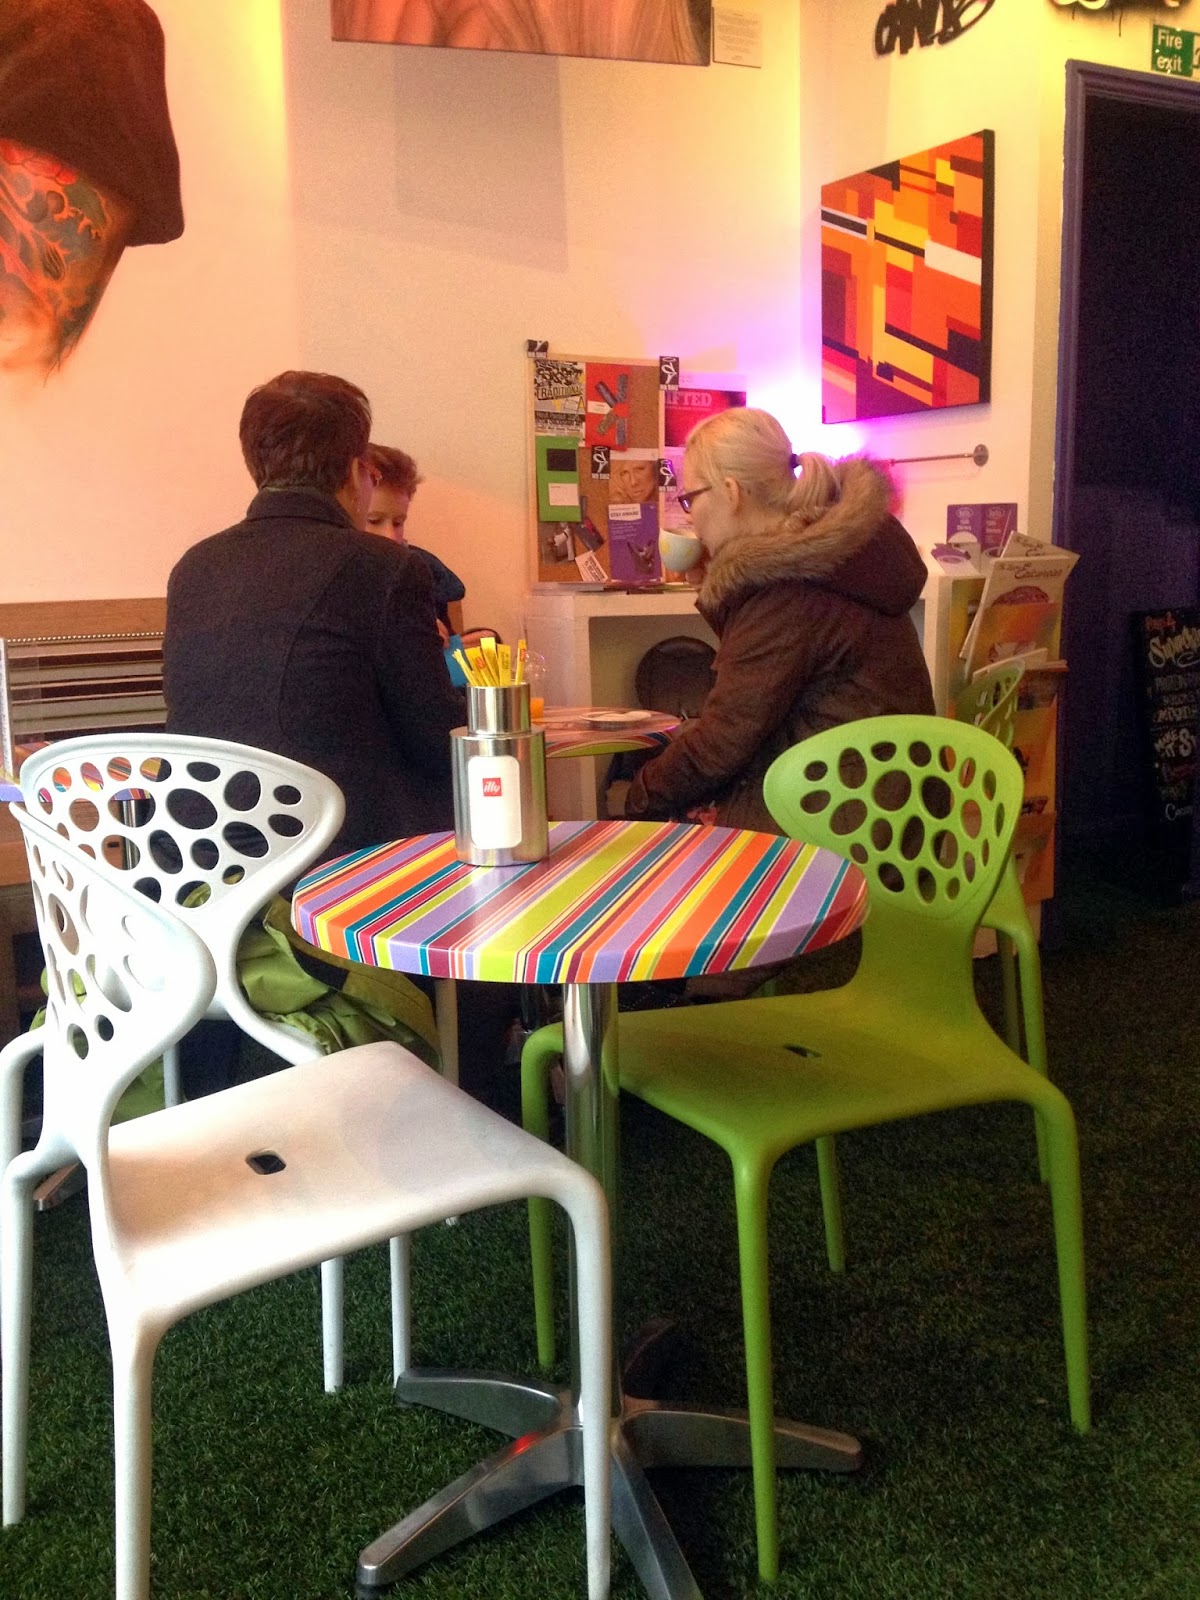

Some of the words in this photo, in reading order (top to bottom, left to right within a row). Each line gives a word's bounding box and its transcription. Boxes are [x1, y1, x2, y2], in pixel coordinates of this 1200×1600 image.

[1158, 29, 1183, 50] Fire
[1157, 55, 1182, 72] exit
[484, 780, 500, 794] illy
